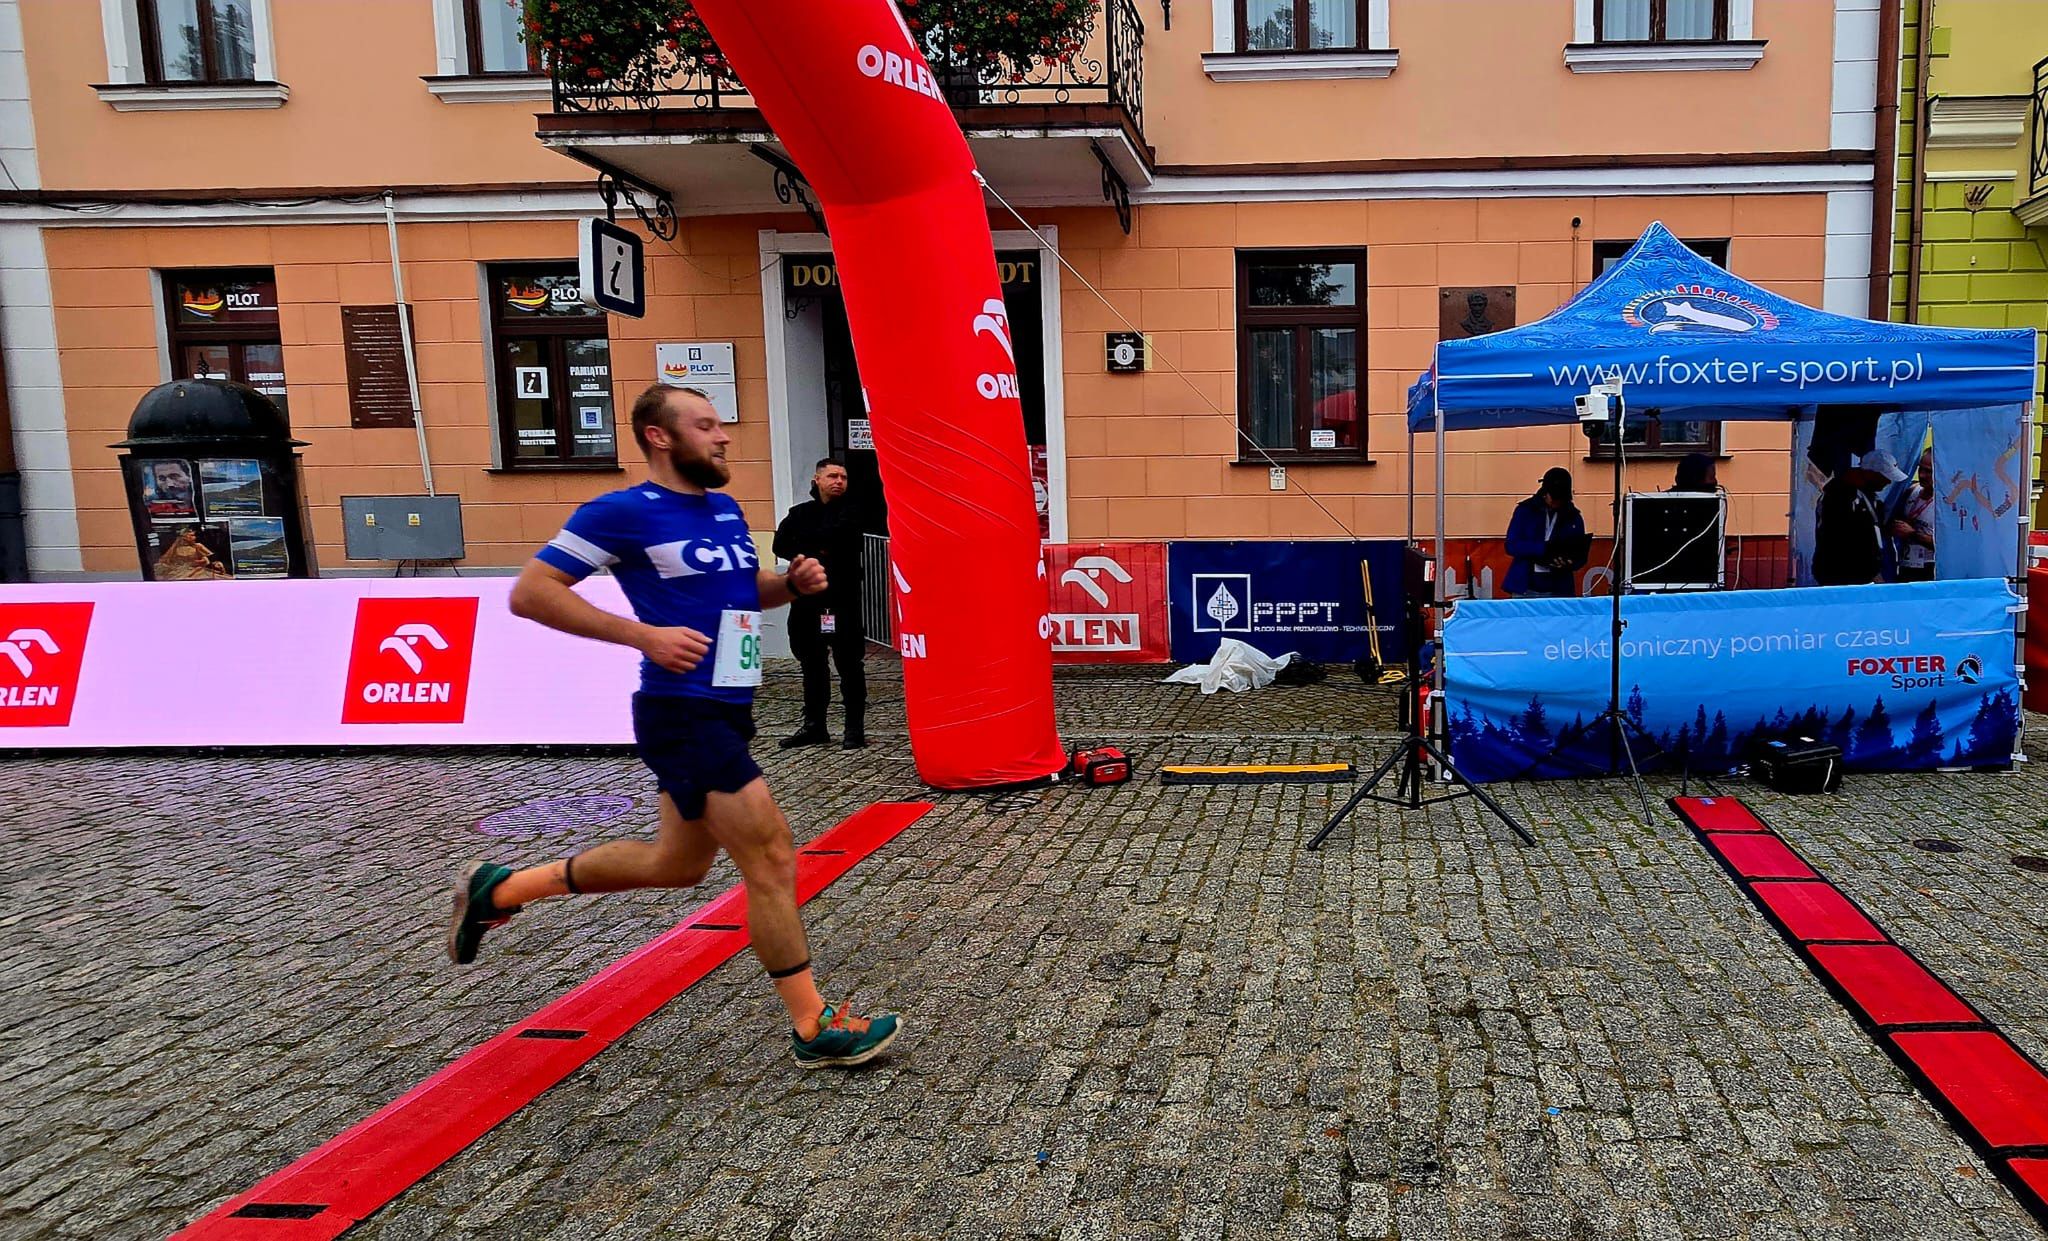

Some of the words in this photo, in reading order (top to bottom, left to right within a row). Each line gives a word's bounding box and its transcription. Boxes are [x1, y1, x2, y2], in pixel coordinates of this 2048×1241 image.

[857, 45, 944, 104] ORLEN
[226, 294, 260, 306] PLOT
[551, 287, 581, 300] PLO
[1122, 349, 1128, 360] 8
[1548, 352, 1923, 390] www.foxter-sport.pl
[976, 373, 1020, 399] ORL
[1253, 602, 1340, 622] PPPT
[1543, 635, 1722, 660] elektoniczny
[1730, 628, 1828, 658] pomiar
[1834, 628, 1910, 648] czasu
[1847, 655, 1946, 676] FOXTER
[363, 682, 450, 703] ORLEN
[1891, 672, 1945, 692] Sport
